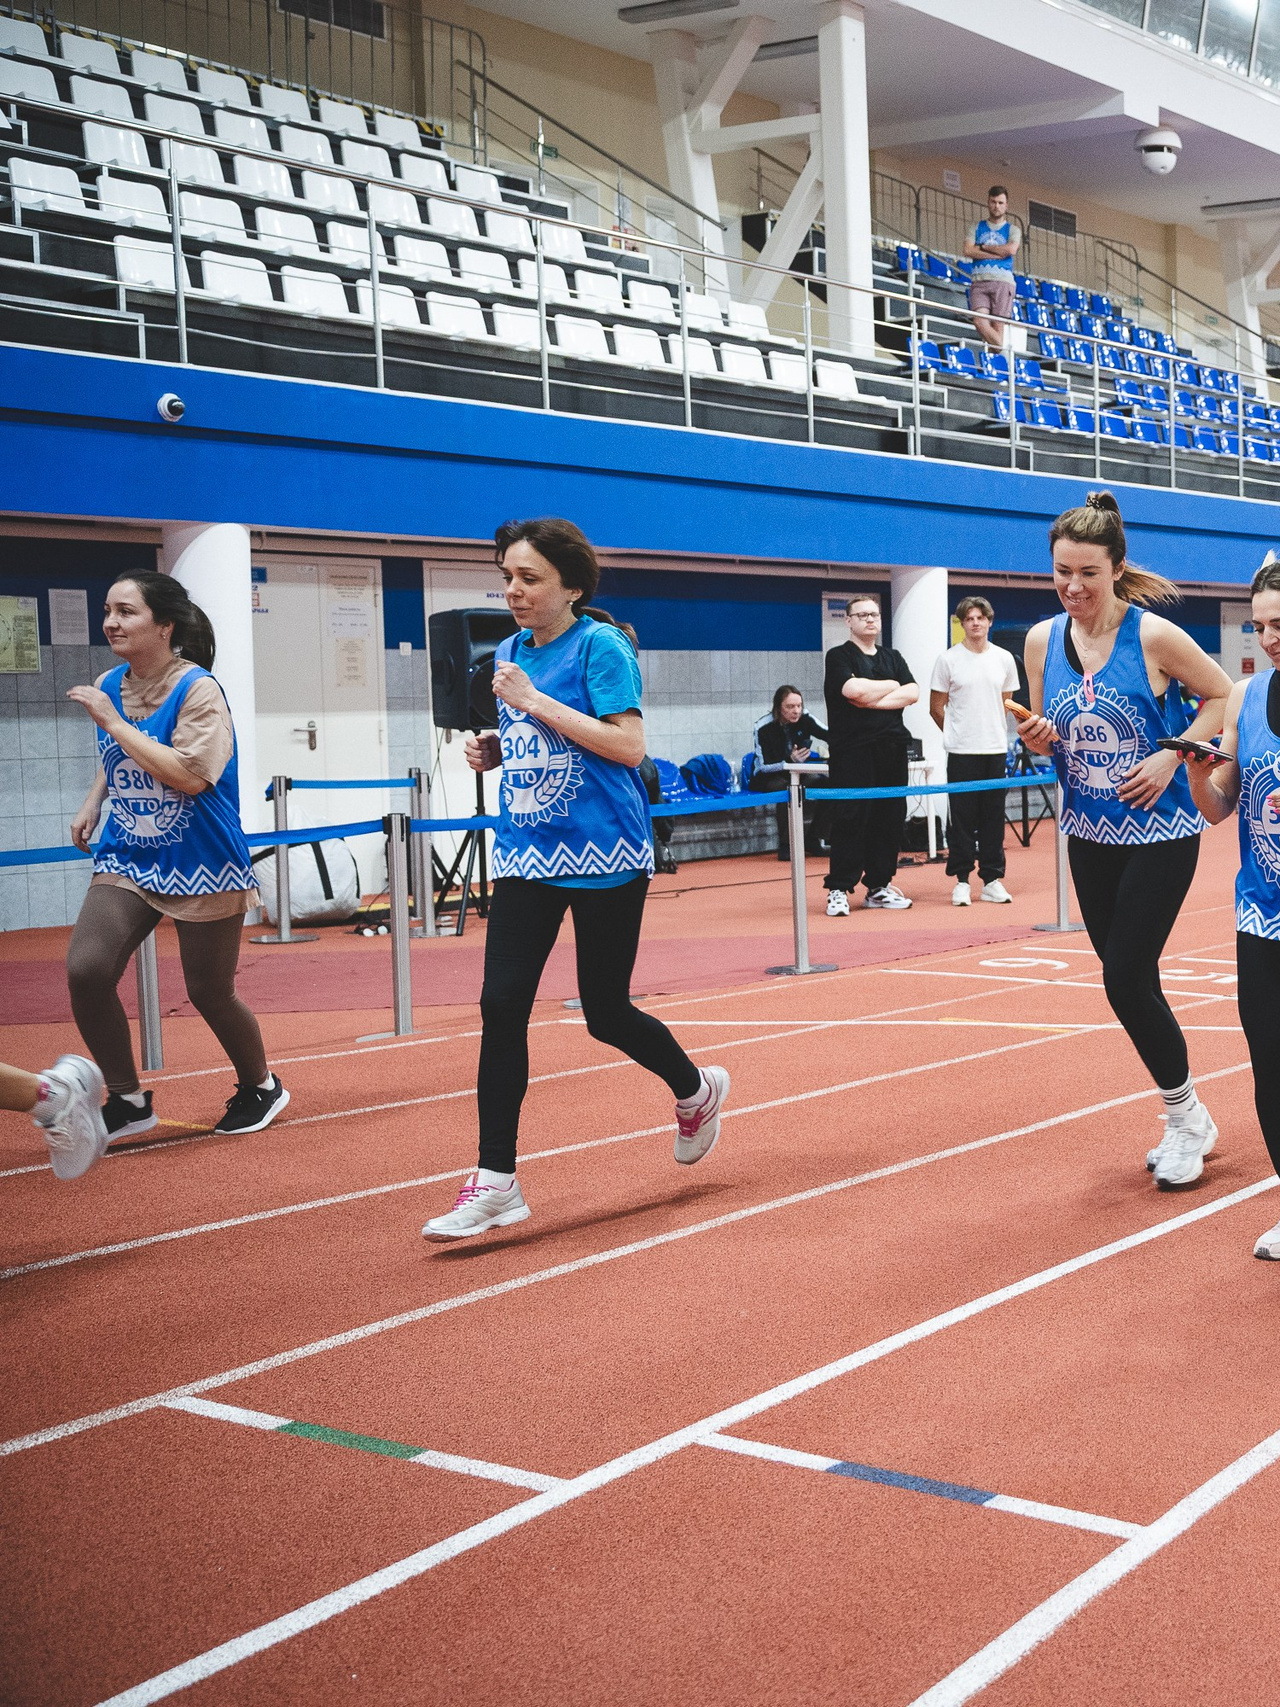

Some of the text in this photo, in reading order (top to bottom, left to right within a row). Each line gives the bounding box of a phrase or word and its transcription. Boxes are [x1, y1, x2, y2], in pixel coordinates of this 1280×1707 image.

[1074, 725, 1107, 743] 186
[503, 735, 540, 761] 304
[1083, 750, 1110, 765] ГТО
[116, 768, 154, 790] 380
[508, 770, 537, 784] ГТО
[127, 799, 158, 812] ГТО
